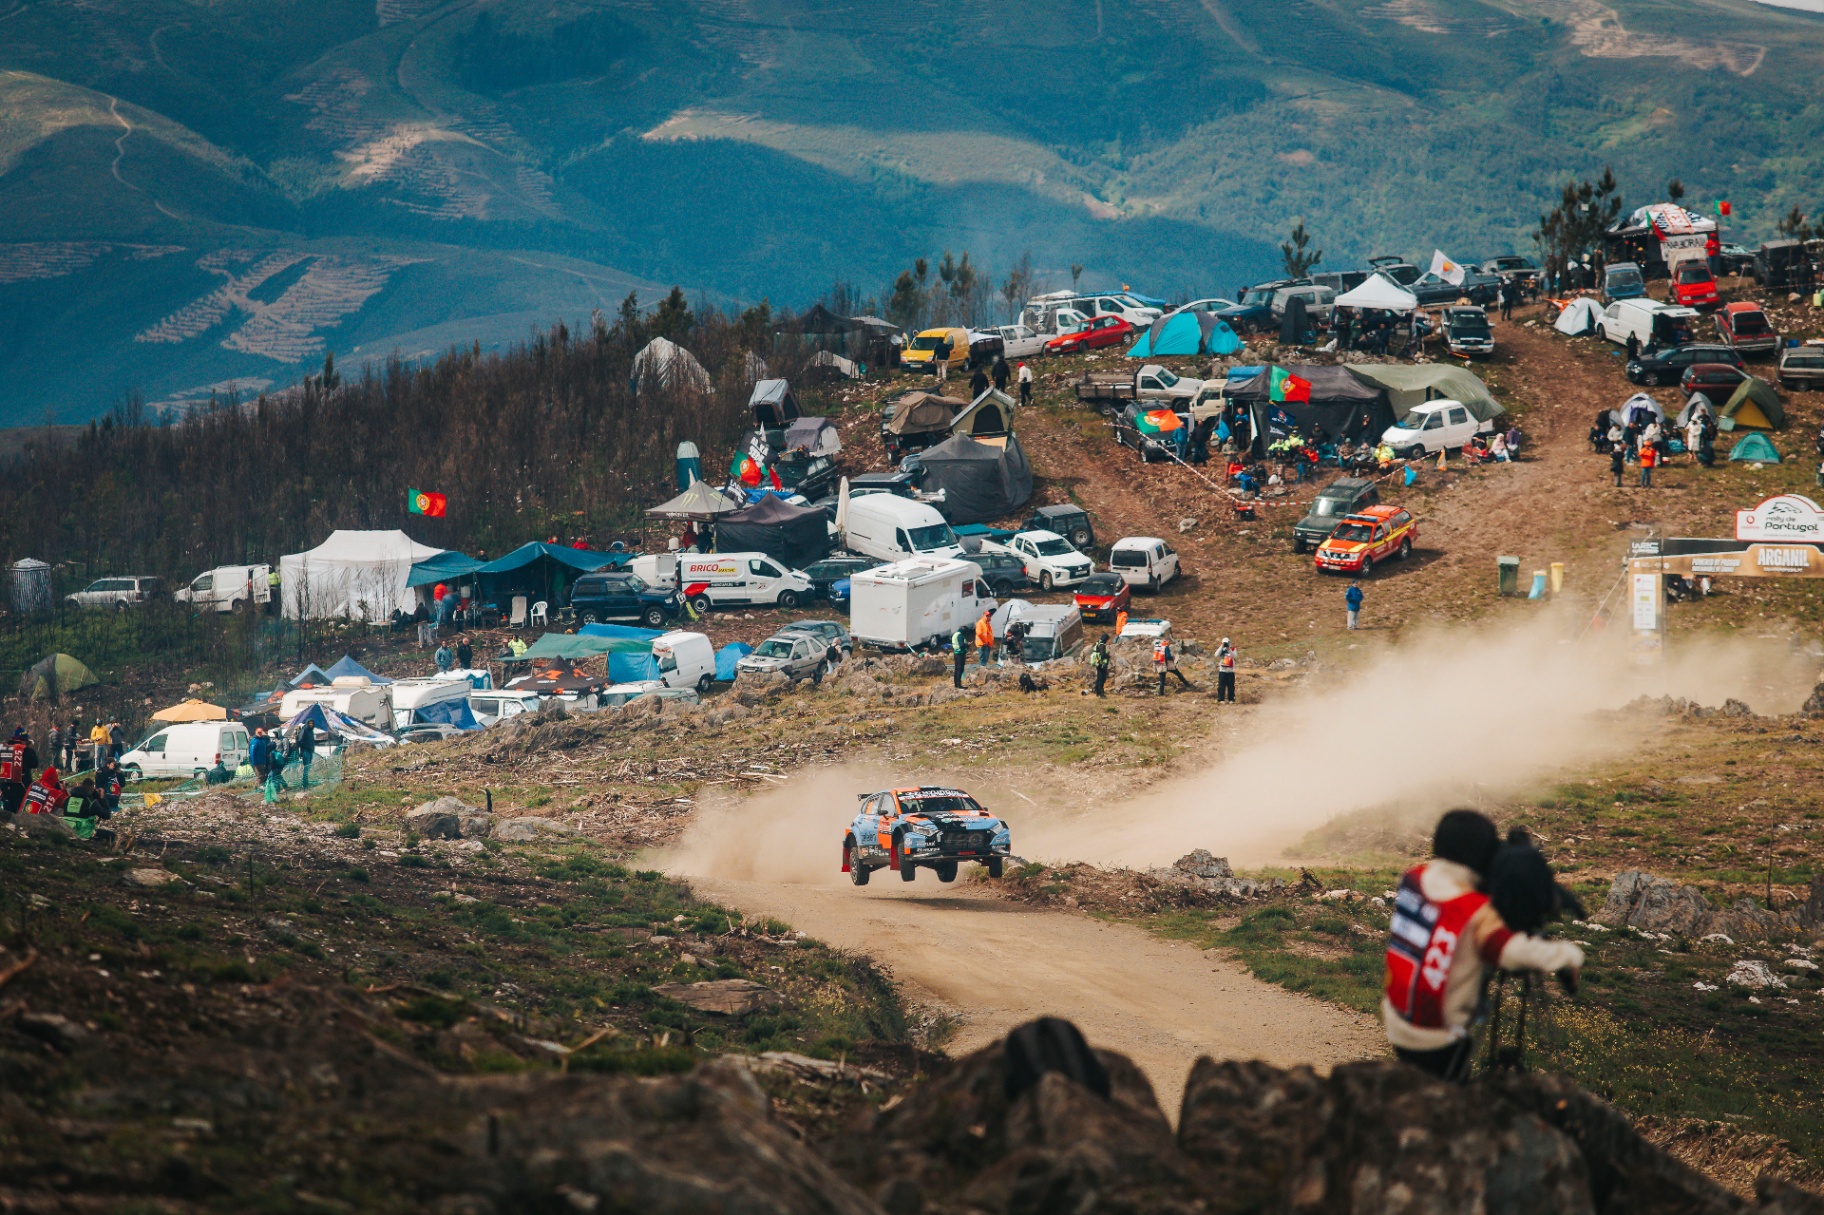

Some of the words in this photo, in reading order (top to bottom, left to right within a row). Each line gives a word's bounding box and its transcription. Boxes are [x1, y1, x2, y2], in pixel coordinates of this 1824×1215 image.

[1765, 522, 1819, 532] Portugal
[1757, 548, 1809, 566] ARGANIL
[690, 564, 718, 572] BRICO
[14, 750, 22, 767] 225
[43, 796, 55, 812] 215
